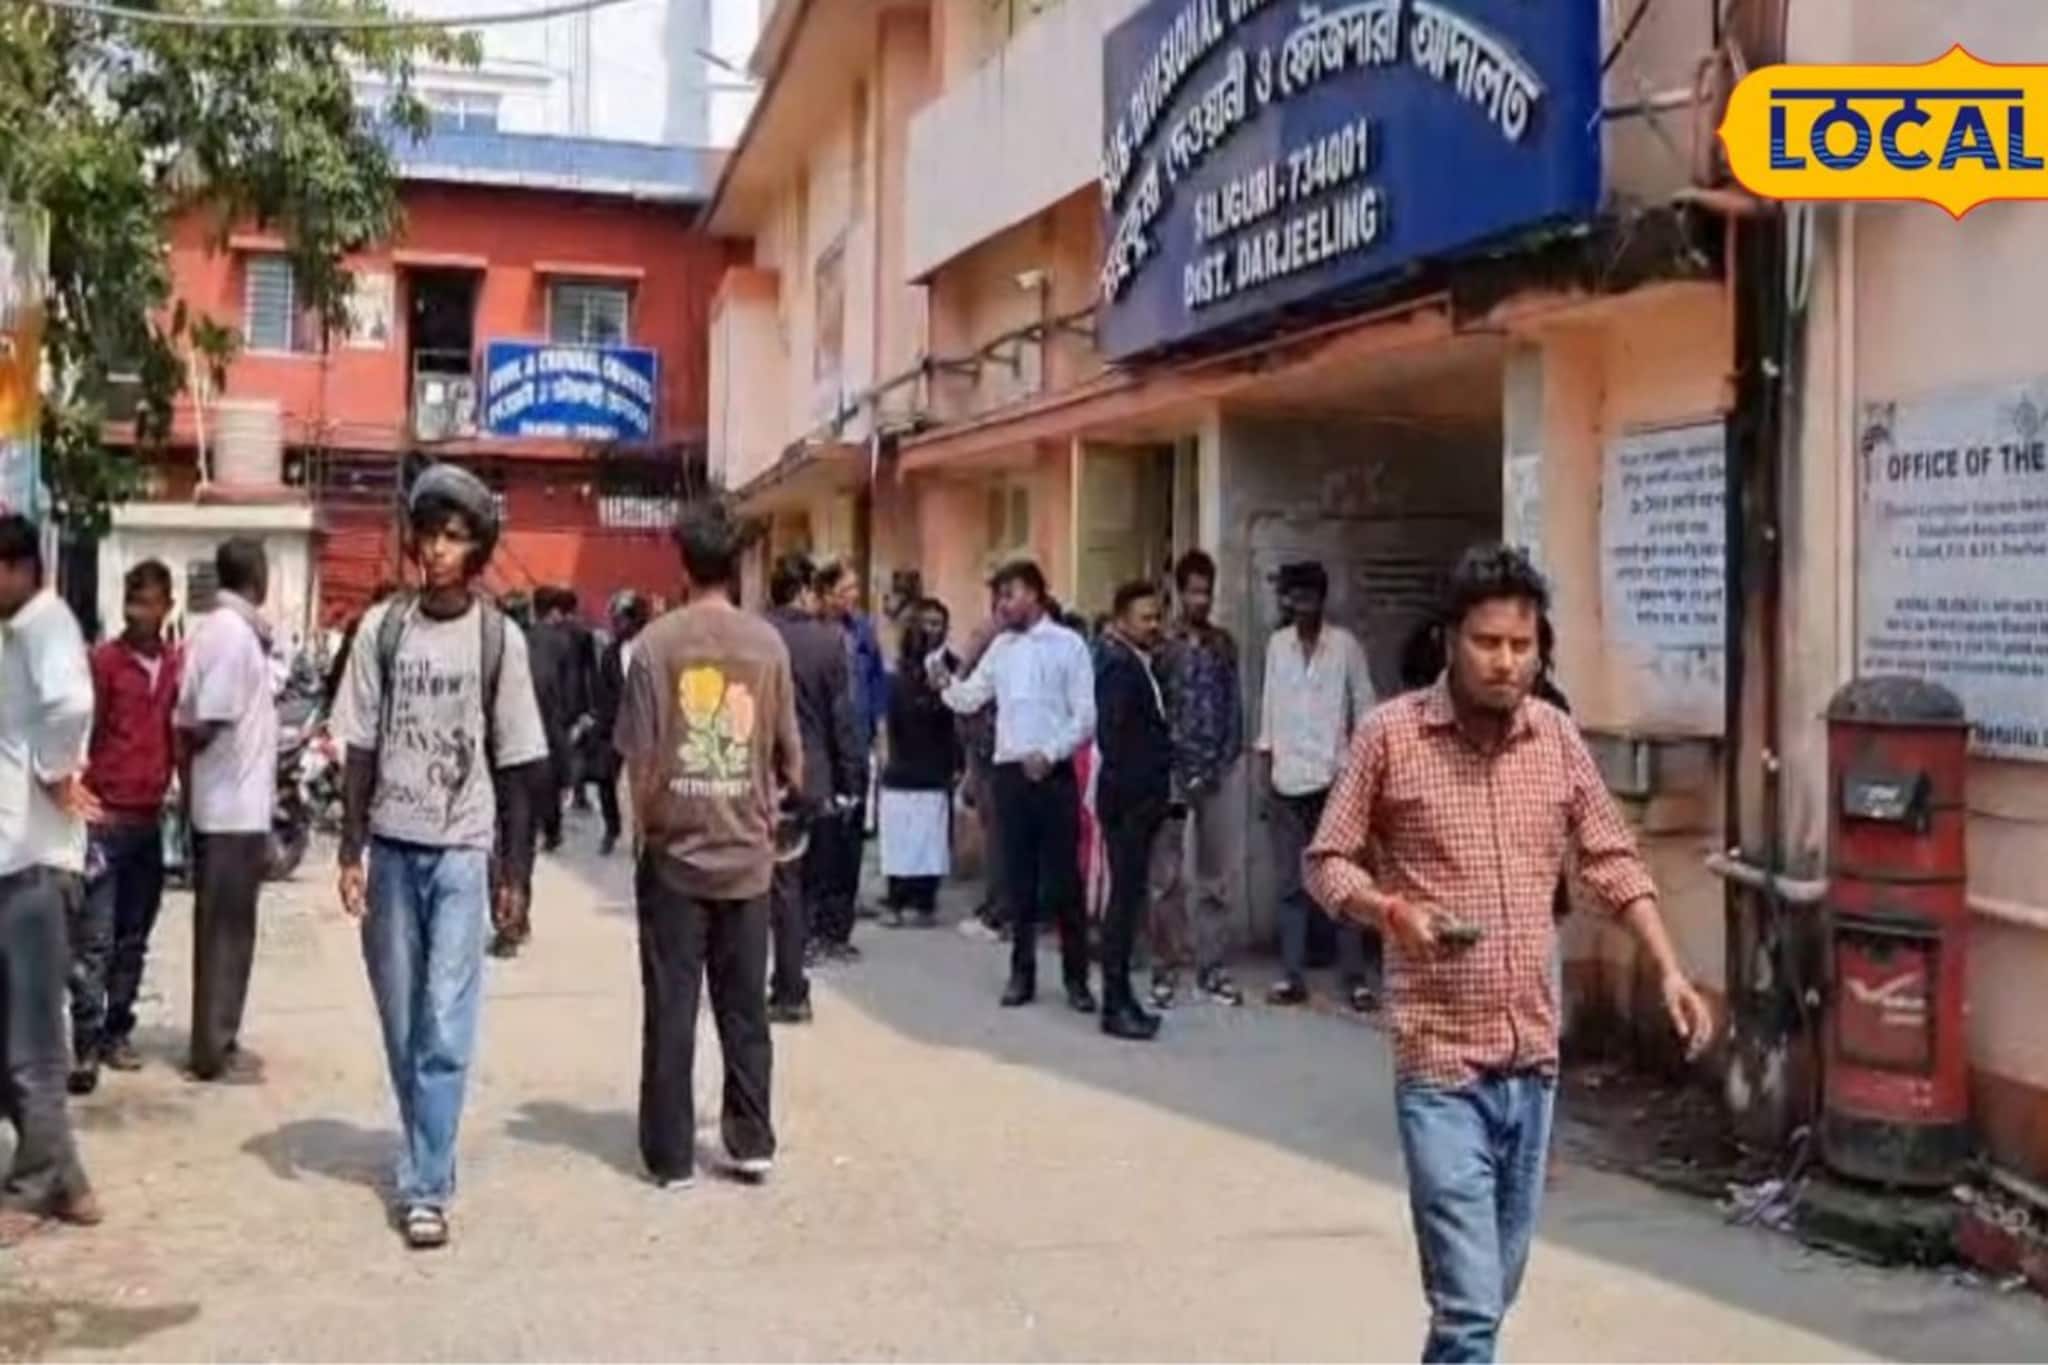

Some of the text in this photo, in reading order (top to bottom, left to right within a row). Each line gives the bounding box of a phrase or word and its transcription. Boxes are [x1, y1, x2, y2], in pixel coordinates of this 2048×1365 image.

[1255, 46, 1272, 104] ও
[1411, 0, 1540, 141] আদালত
[1183, 189, 1377, 308] DIST. DARJEELING
[1887, 441, 2046, 481] OFFICE OF THE
